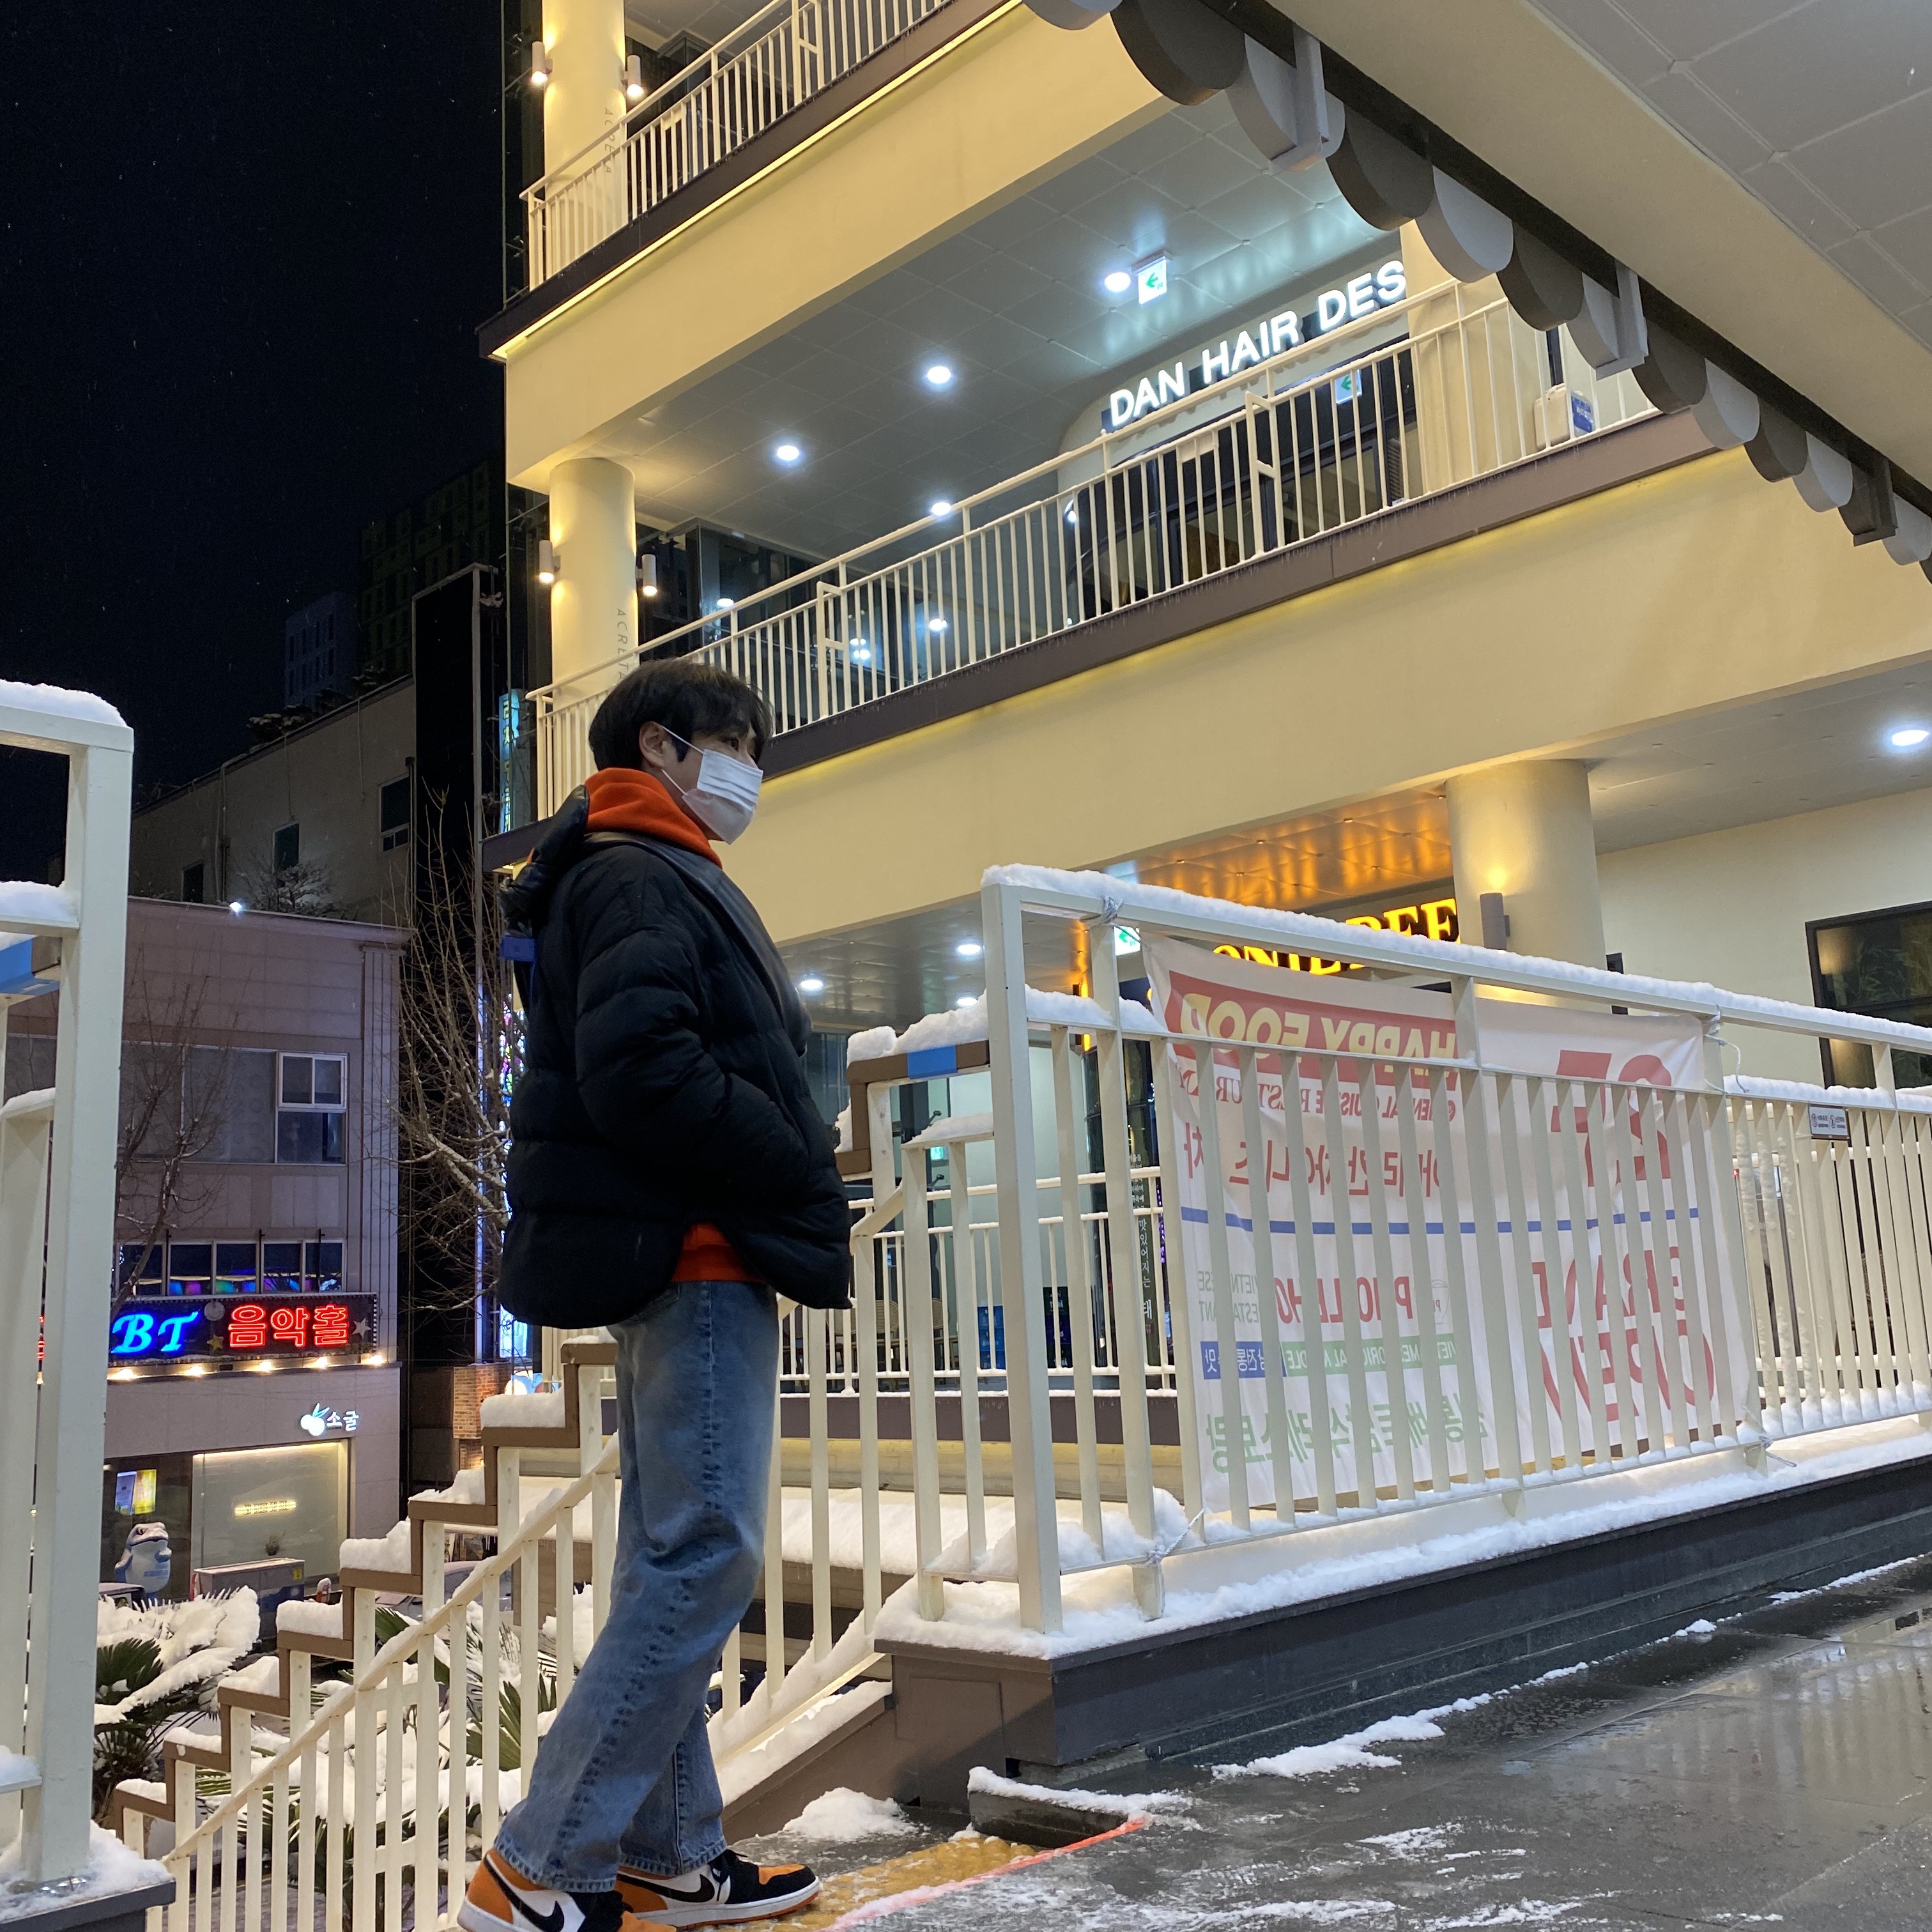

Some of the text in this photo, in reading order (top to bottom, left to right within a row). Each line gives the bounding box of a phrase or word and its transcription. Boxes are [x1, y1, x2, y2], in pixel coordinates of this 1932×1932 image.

[604, 107, 615, 173] ACREA
[1110, 260, 1406, 426] DAN HAIR DES
[1138, 1218, 1151, 1289] 맛있어지는
[111, 1310, 200, 1354] BT
[228, 1305, 348, 1347] 음악홀
